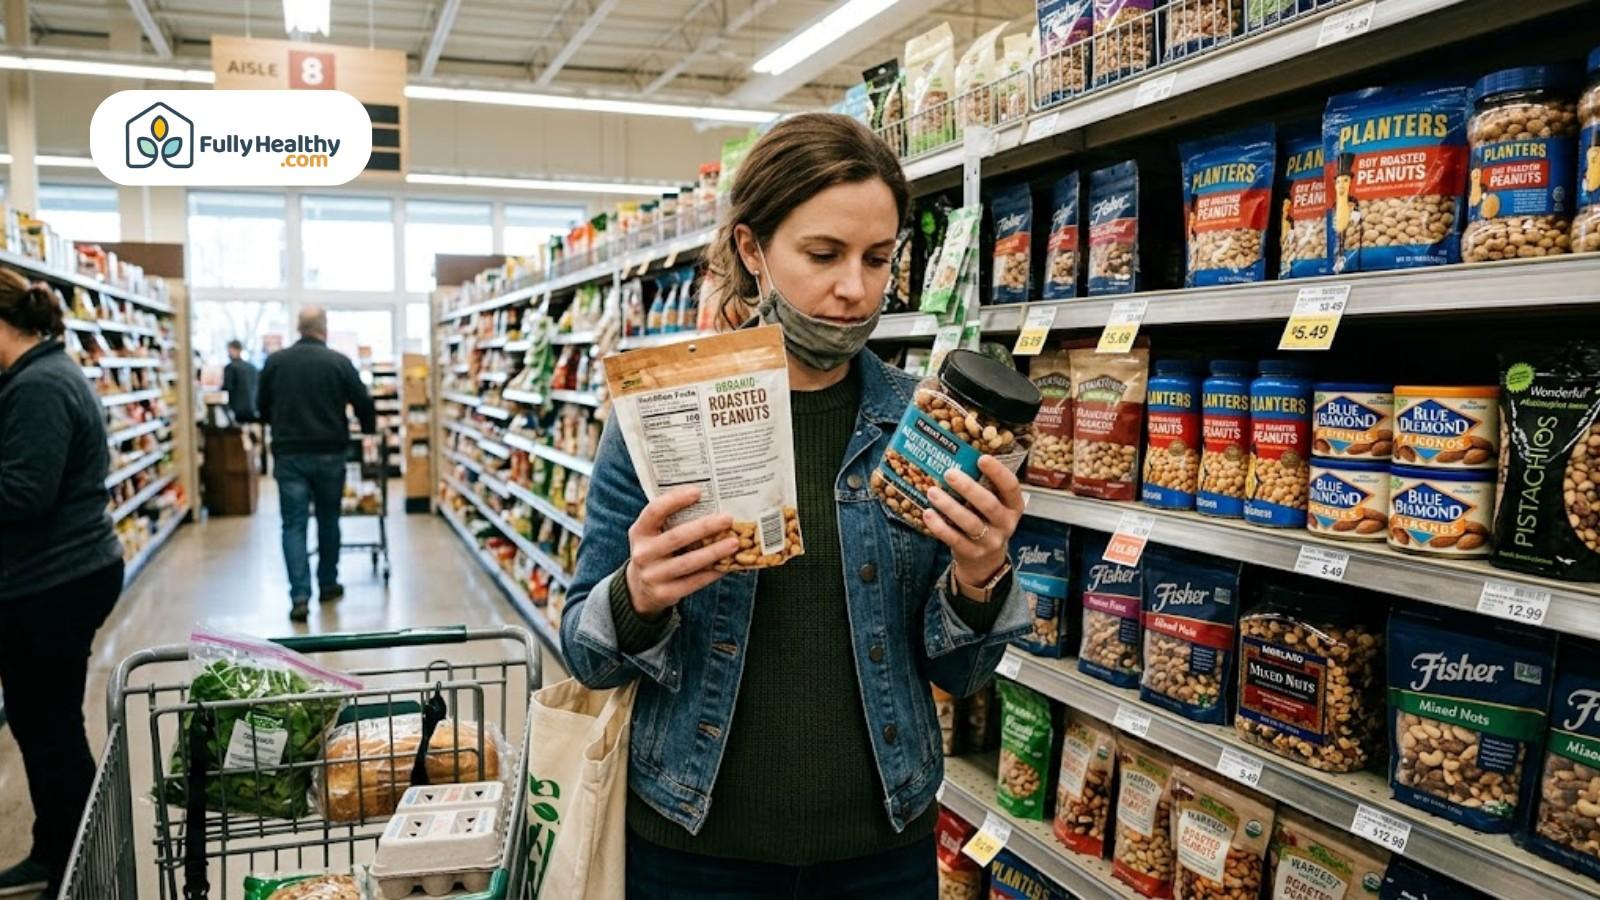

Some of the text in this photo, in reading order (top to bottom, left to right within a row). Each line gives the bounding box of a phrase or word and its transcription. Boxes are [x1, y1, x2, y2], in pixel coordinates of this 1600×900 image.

[227, 56, 324, 85] AISLE 8
[1339, 112, 1448, 150] PLANTERS
[1484, 142, 1547, 163] PLANTERS
[1191, 162, 1257, 194] PLANTERS
[1356, 164, 1427, 185] PEANUTS
[1489, 171, 1542, 187] PEANUTS
[1197, 203, 1241, 221] PEANUTS
[708, 388, 767, 411] ROASTED
[1328, 402, 1359, 416] BLUE
[711, 405, 770, 428] PEANUTS
[1316, 478, 1344, 493] BLUE
[1514, 416, 1559, 548] PISTACHIOS
[1408, 488, 1443, 506] BLUE
[1151, 581, 1210, 612] Fisher
[1507, 603, 1543, 621] 12.99
[1409, 651, 1505, 692] Fisher
